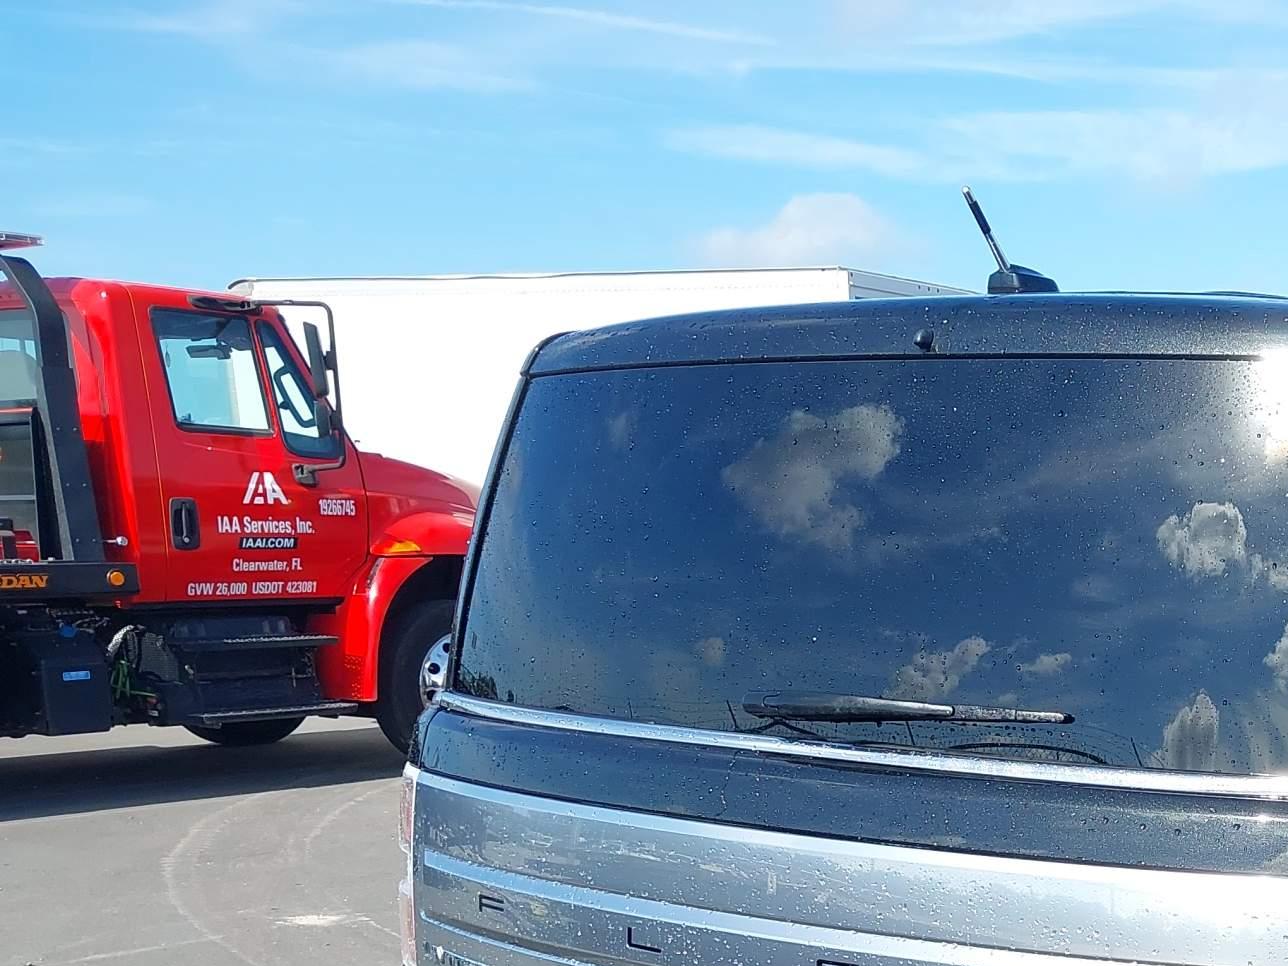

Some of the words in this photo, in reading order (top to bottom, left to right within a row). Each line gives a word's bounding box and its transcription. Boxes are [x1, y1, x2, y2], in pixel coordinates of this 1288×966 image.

[318, 499, 356, 516] 19266745
[217, 516, 241, 533] IAA
[243, 516, 295, 535] Services,
[296, 517, 316, 533] Inc.
[242, 538, 295, 548] IAAI.COM
[232, 558, 290, 572] Clearwater,
[291, 558, 303, 570] FL
[187, 583, 214, 596] GVW
[216, 583, 247, 596] 26,000
[252, 582, 284, 594] USDOT
[286, 582, 317, 593] 423081
